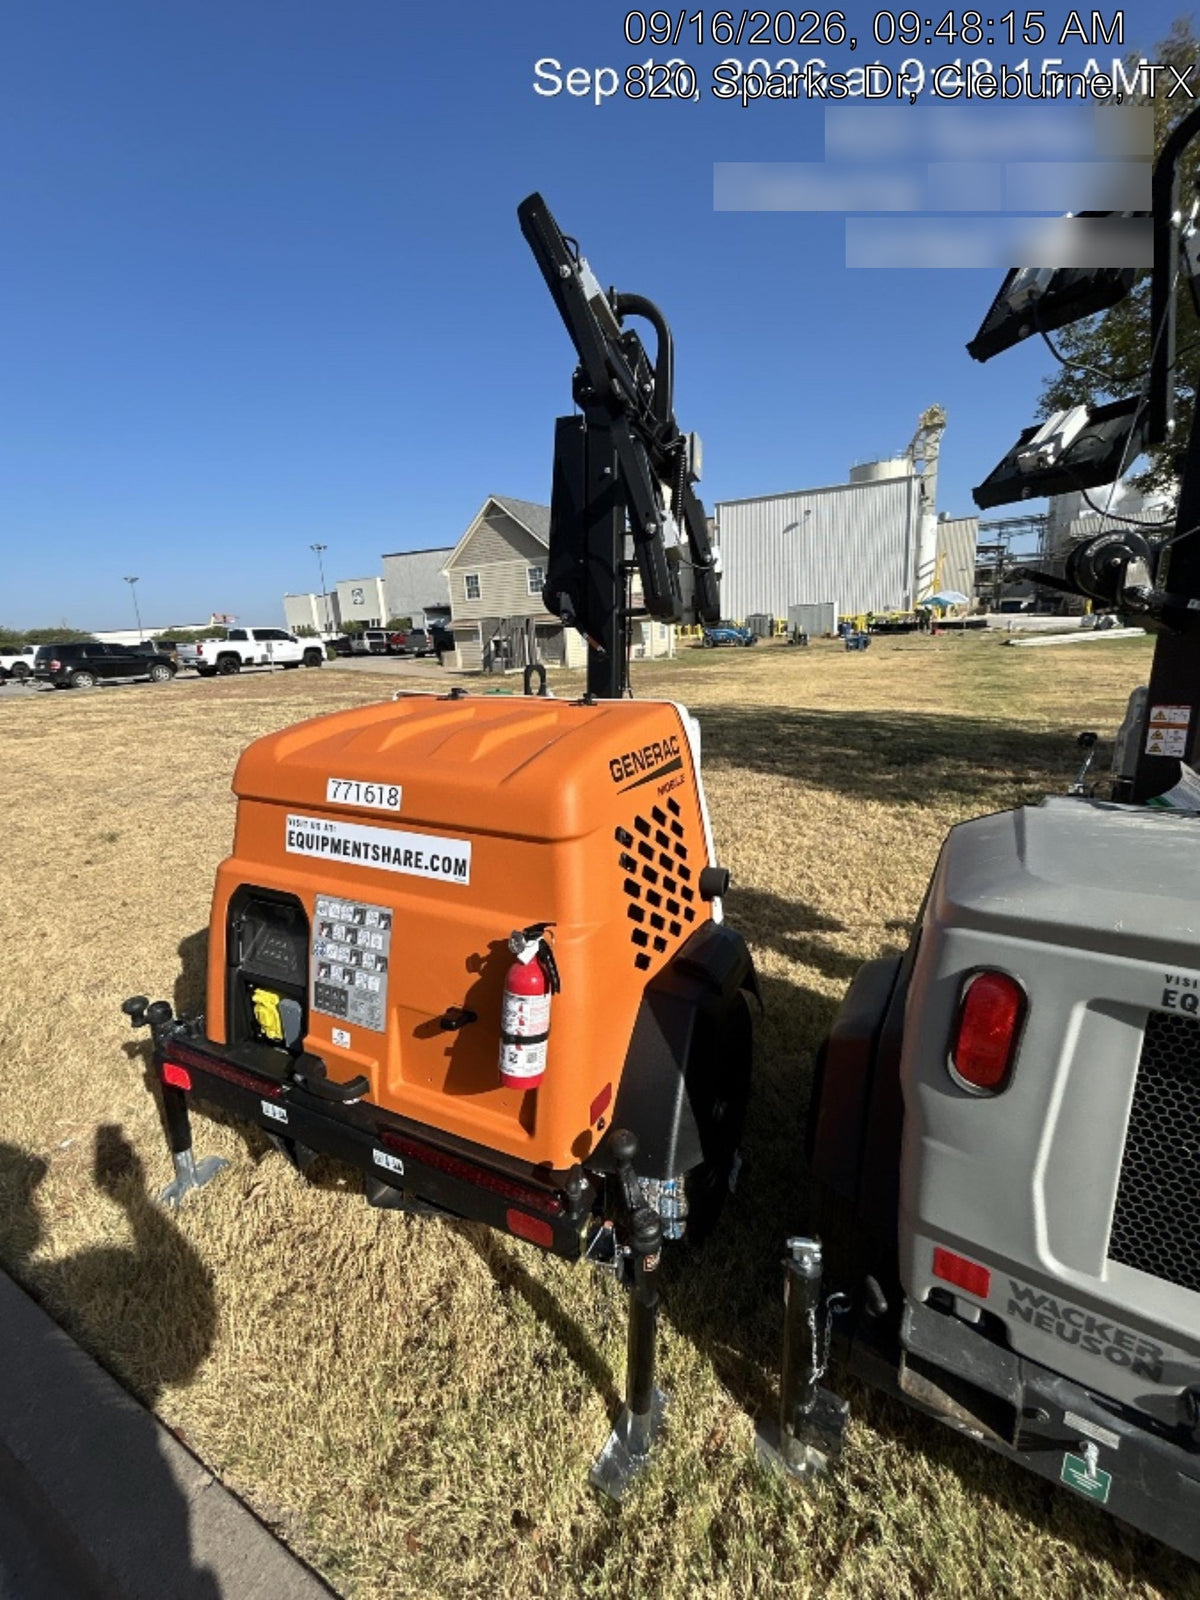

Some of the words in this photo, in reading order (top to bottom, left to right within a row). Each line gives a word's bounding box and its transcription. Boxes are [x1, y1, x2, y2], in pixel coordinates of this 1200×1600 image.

[609, 735, 680, 783] GENERAC
[331, 780, 400, 807] 771618
[287, 830, 467, 878] EQUIPMENTSHARE.COM
[1007, 1299, 1164, 1383] NEUSON
[1009, 1279, 1164, 1358] WACKER
